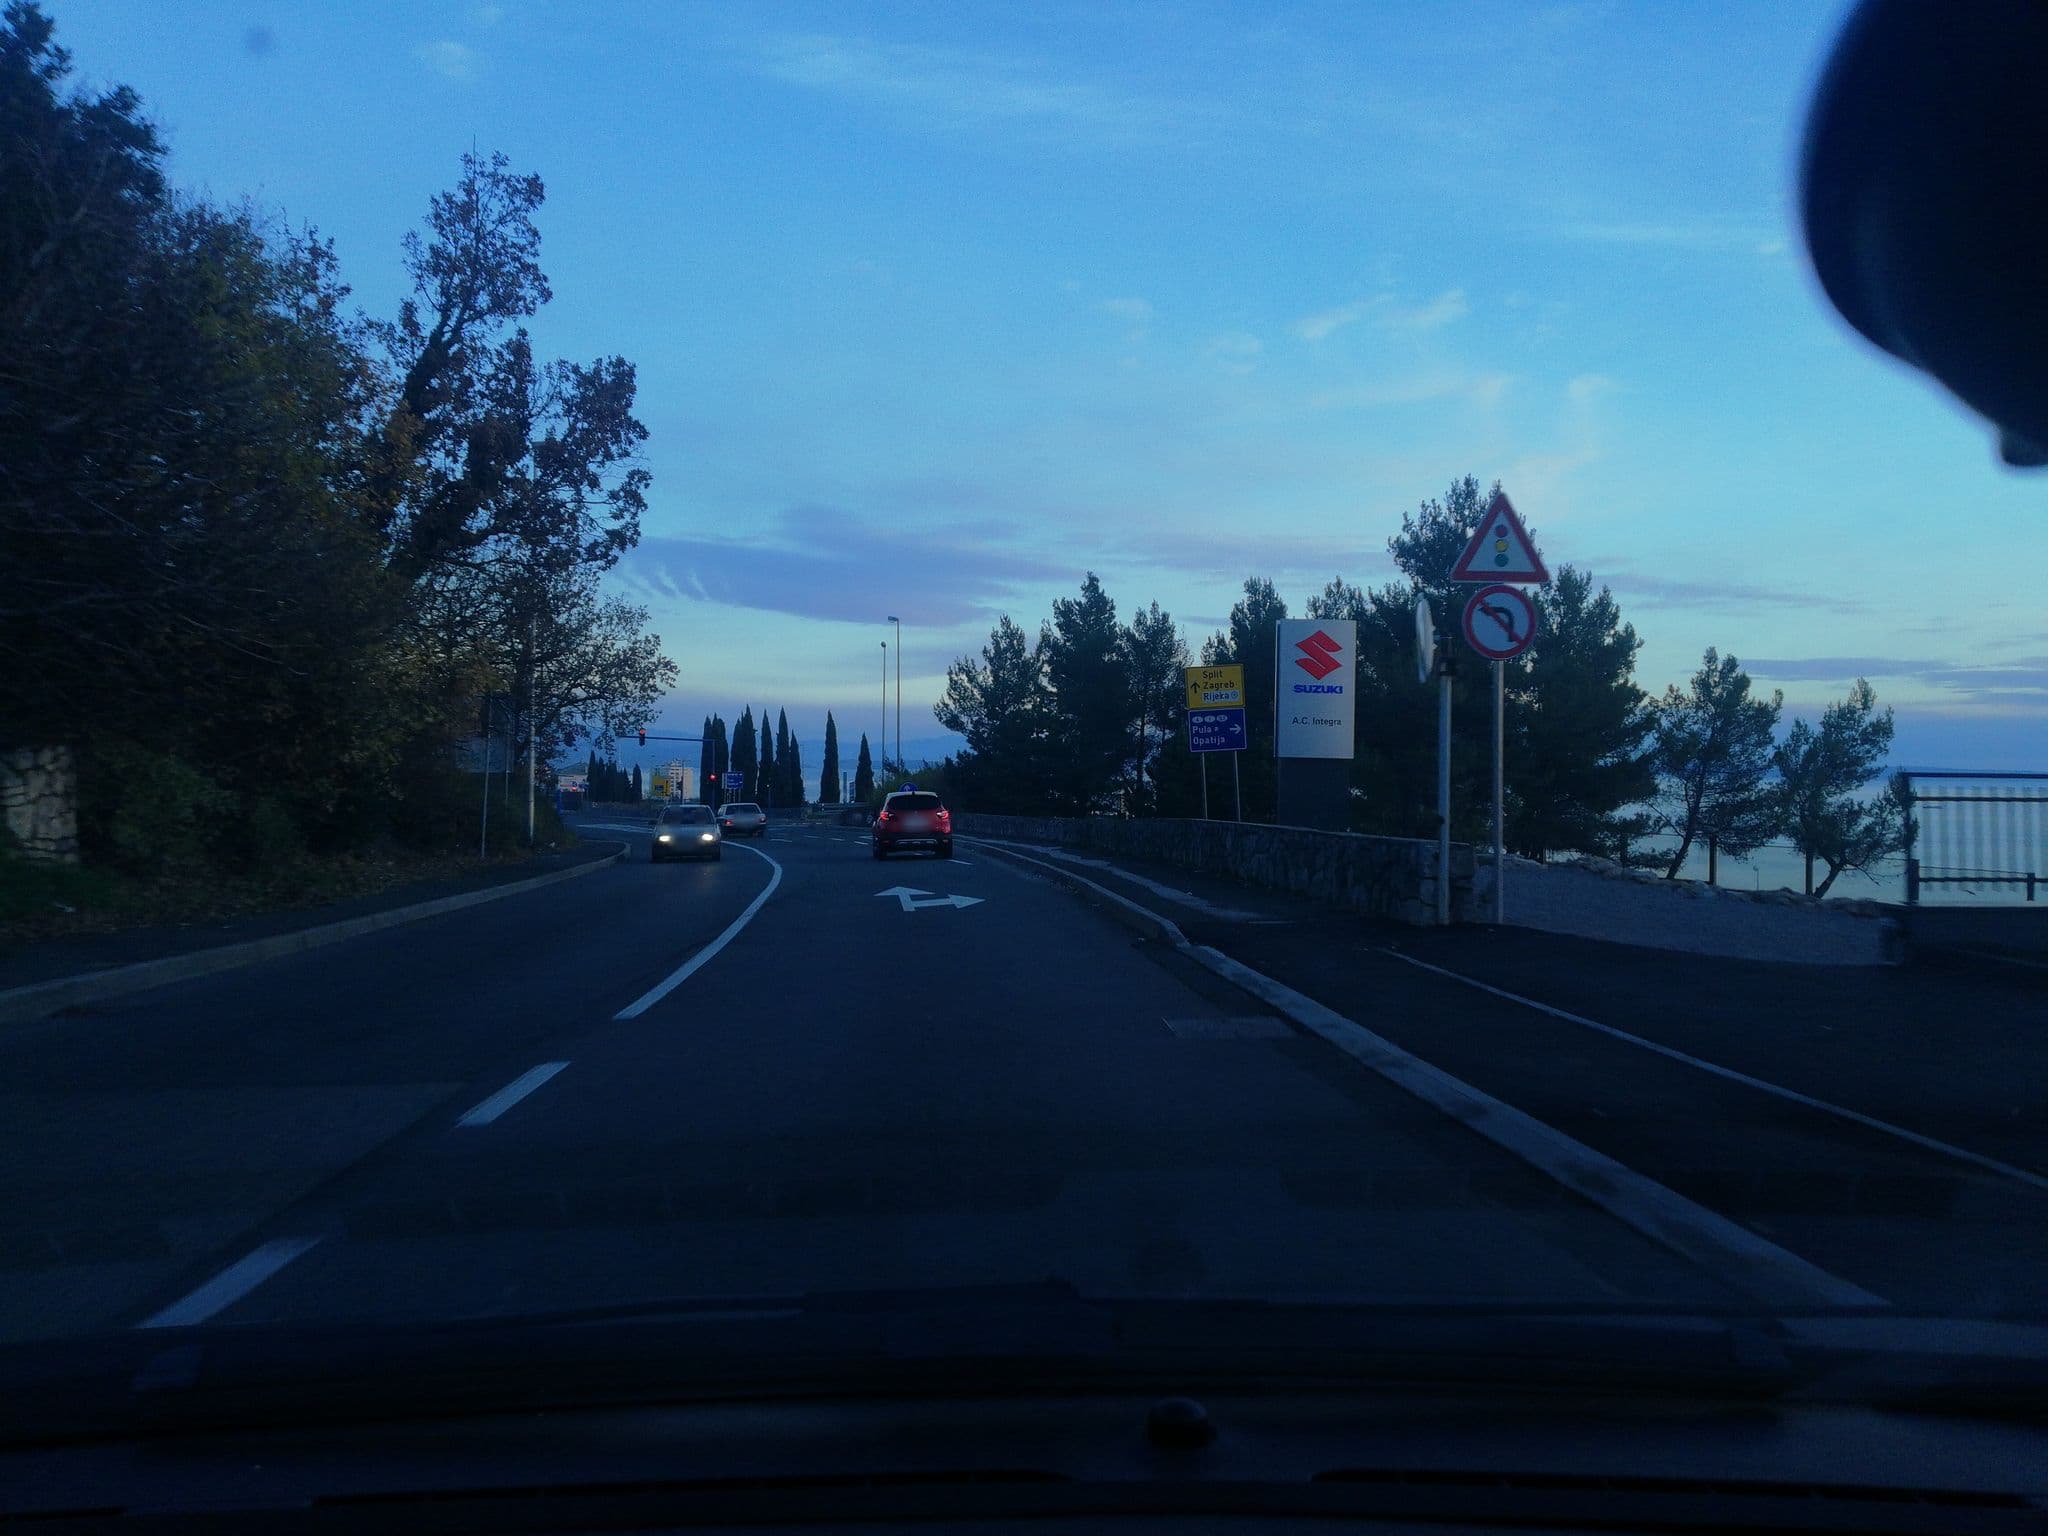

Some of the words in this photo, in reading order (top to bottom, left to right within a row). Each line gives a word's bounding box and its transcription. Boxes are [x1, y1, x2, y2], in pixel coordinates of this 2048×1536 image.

[1202, 670, 1223, 680] Split
[1202, 680, 1235, 690] Zagreb
[1293, 684, 1344, 694] SUZUKI
[1203, 691, 1230, 702] Rijeka
[1291, 716, 1309, 725] A.C.
[1312, 716, 1342, 726] Integra
[1192, 725, 1212, 734] Pula
[1193, 735, 1226, 746] Opatija
